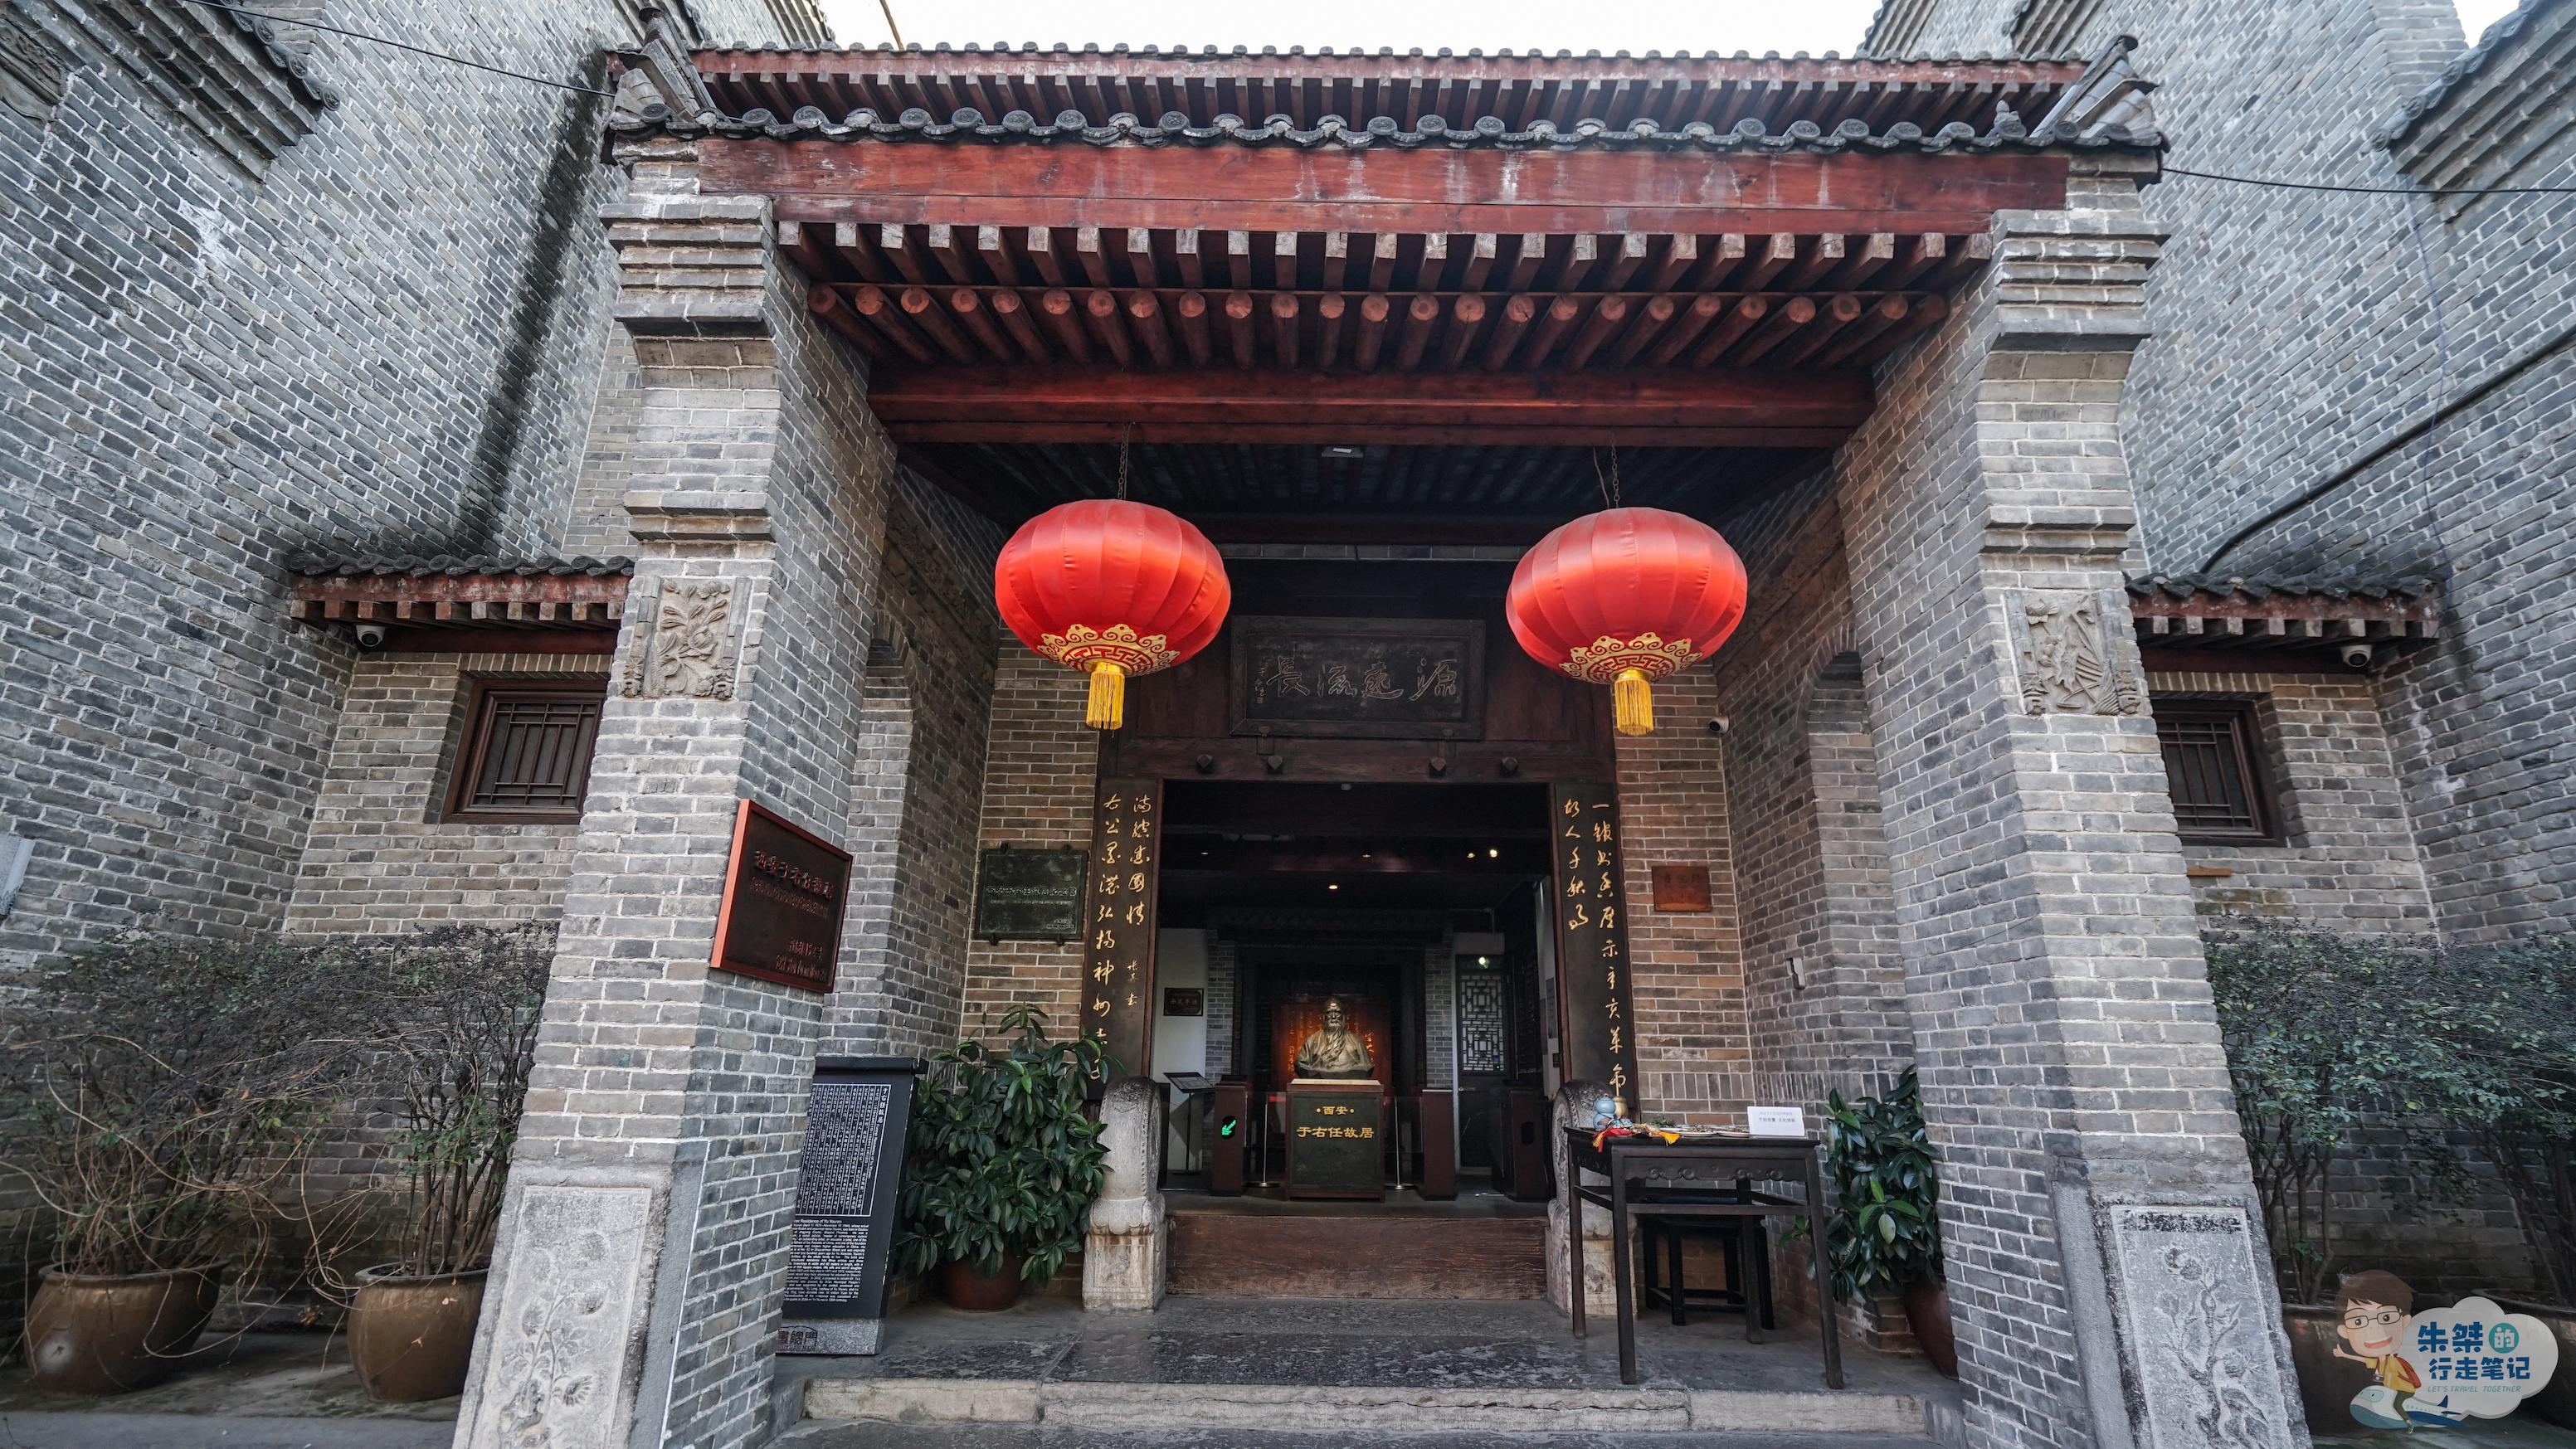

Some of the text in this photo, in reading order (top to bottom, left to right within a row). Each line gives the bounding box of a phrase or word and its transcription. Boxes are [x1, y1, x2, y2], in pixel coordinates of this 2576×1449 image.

[1297, 1126, 1375, 1138] 于右任故居
